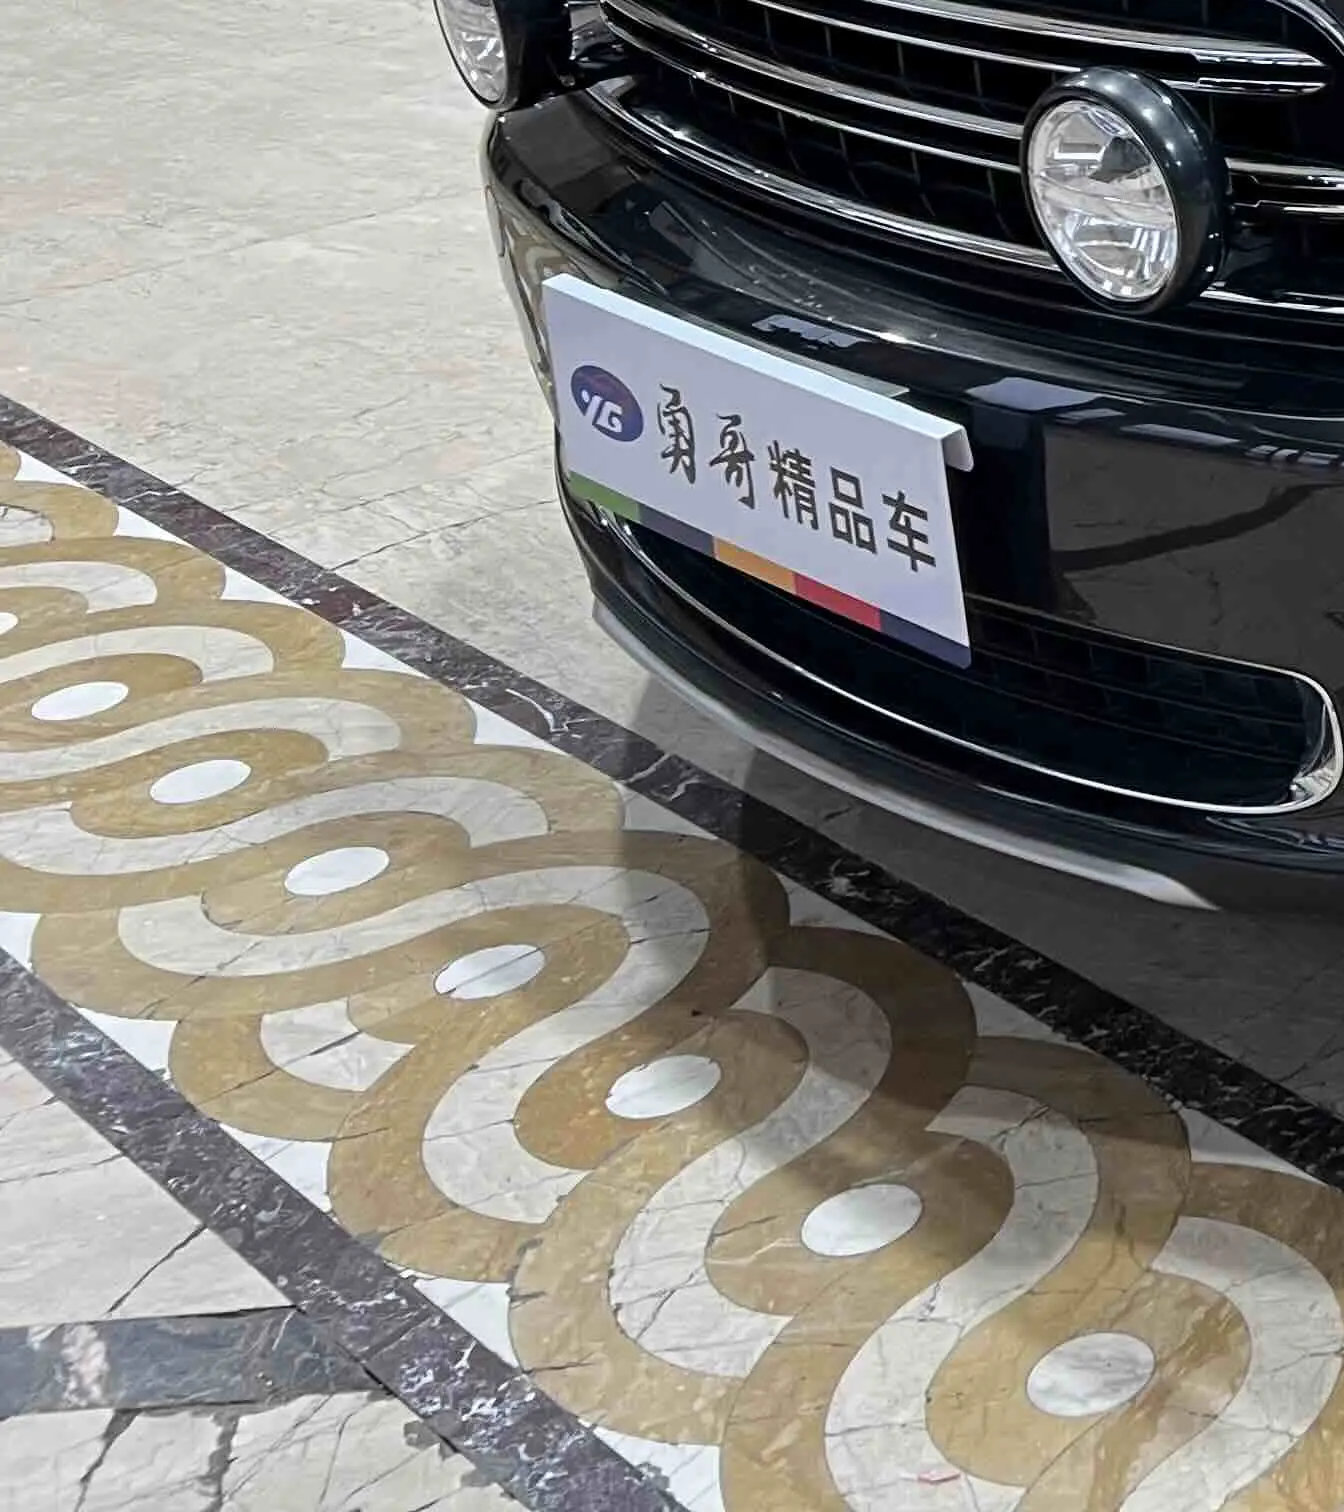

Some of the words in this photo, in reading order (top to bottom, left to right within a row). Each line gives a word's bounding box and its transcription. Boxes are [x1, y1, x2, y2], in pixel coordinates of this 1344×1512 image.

[656, 382, 937, 573] 勇哥精品车
